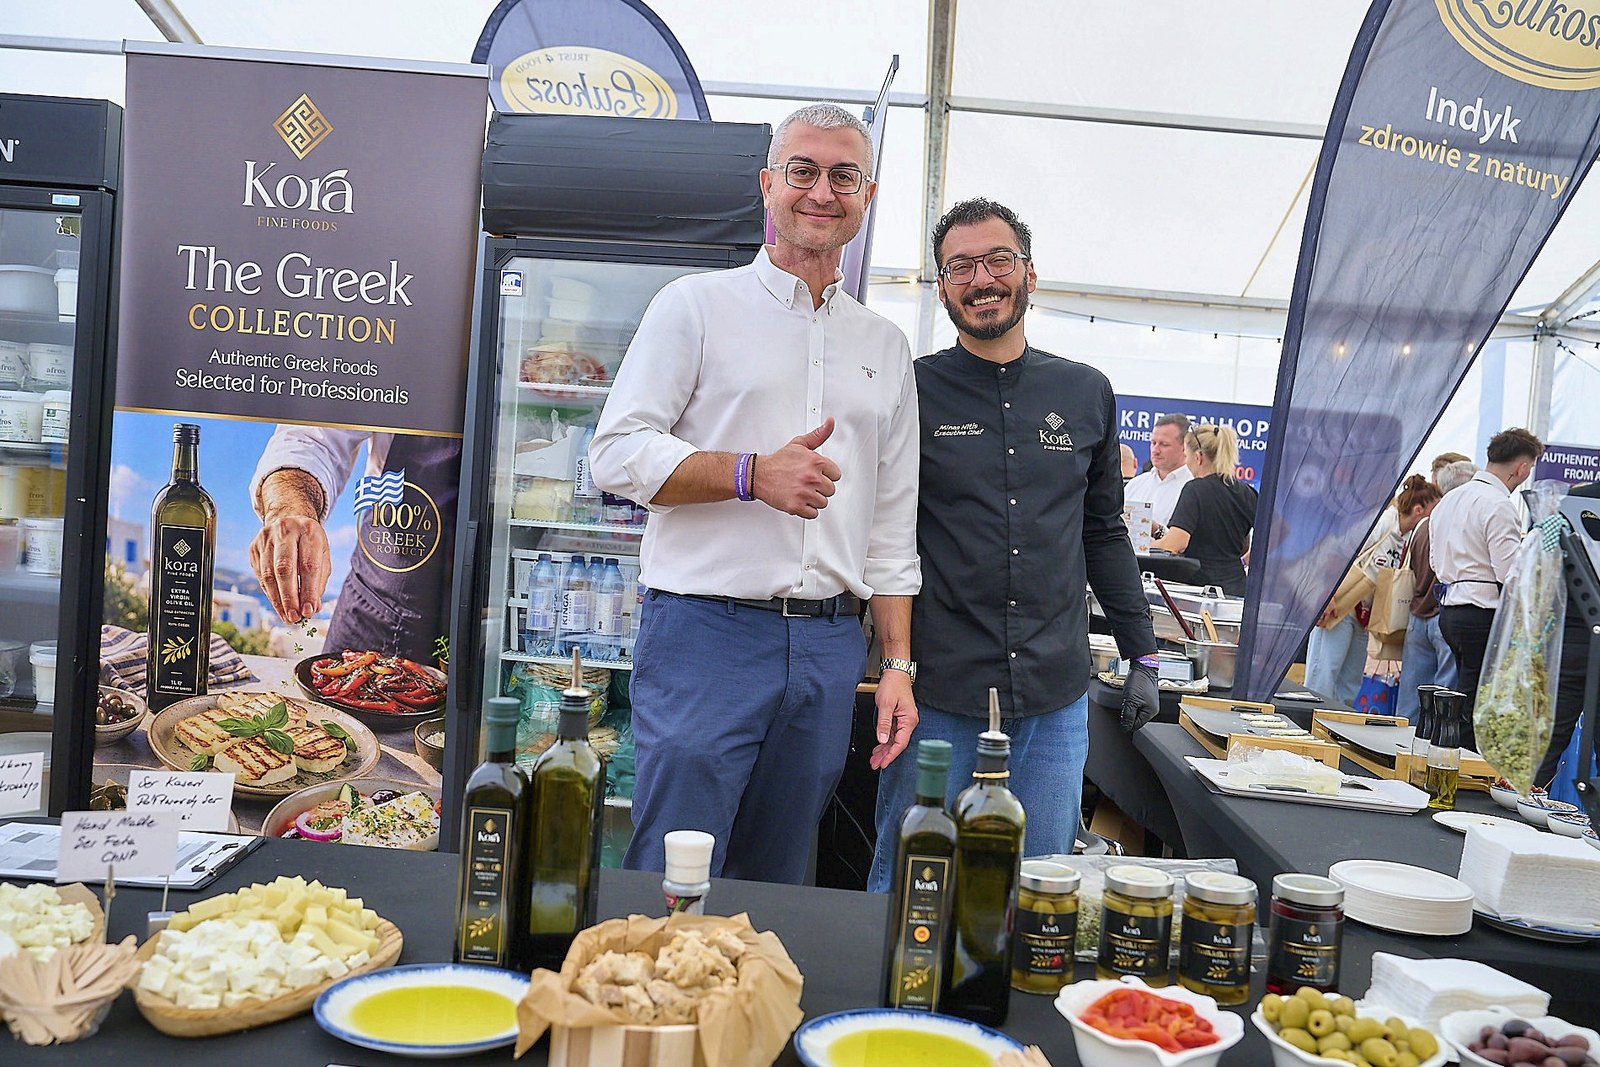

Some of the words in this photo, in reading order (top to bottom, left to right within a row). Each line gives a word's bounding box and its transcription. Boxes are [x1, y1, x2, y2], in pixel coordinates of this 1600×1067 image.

[1472, 0, 1600, 49] ukos
[1425, 86, 1522, 144] Indyk
[1358, 123, 1461, 168] zdrowie
[1466, 153, 1481, 173] z
[1485, 157, 1570, 200] natury
[257, 216, 288, 229] FINE
[292, 218, 338, 232] FOODS
[177, 244, 262, 296] The
[276, 252, 414, 307] Greek
[188, 303, 397, 345] COLLECTION
[208, 349, 281, 370] Authentic
[284, 353, 330, 373] Greek
[333, 358, 378, 377] Foods
[175, 369, 255, 394] Selected
[260, 375, 285, 395] for
[289, 379, 409, 405] Professionals
[967, 428, 985, 436] Chef
[1119, 430, 1152, 442] AUTHE
[1541, 451, 1598, 467] AUTHENTIC
[576, 459, 584, 491] KINGA
[1564, 469, 1593, 480] FROM
[371, 502, 432, 531] 100%
[368, 530, 427, 548] GREEK
[164, 556, 198, 573] kora
[562, 593, 570, 625] KINGA
[103, 834, 136, 847] Feta
